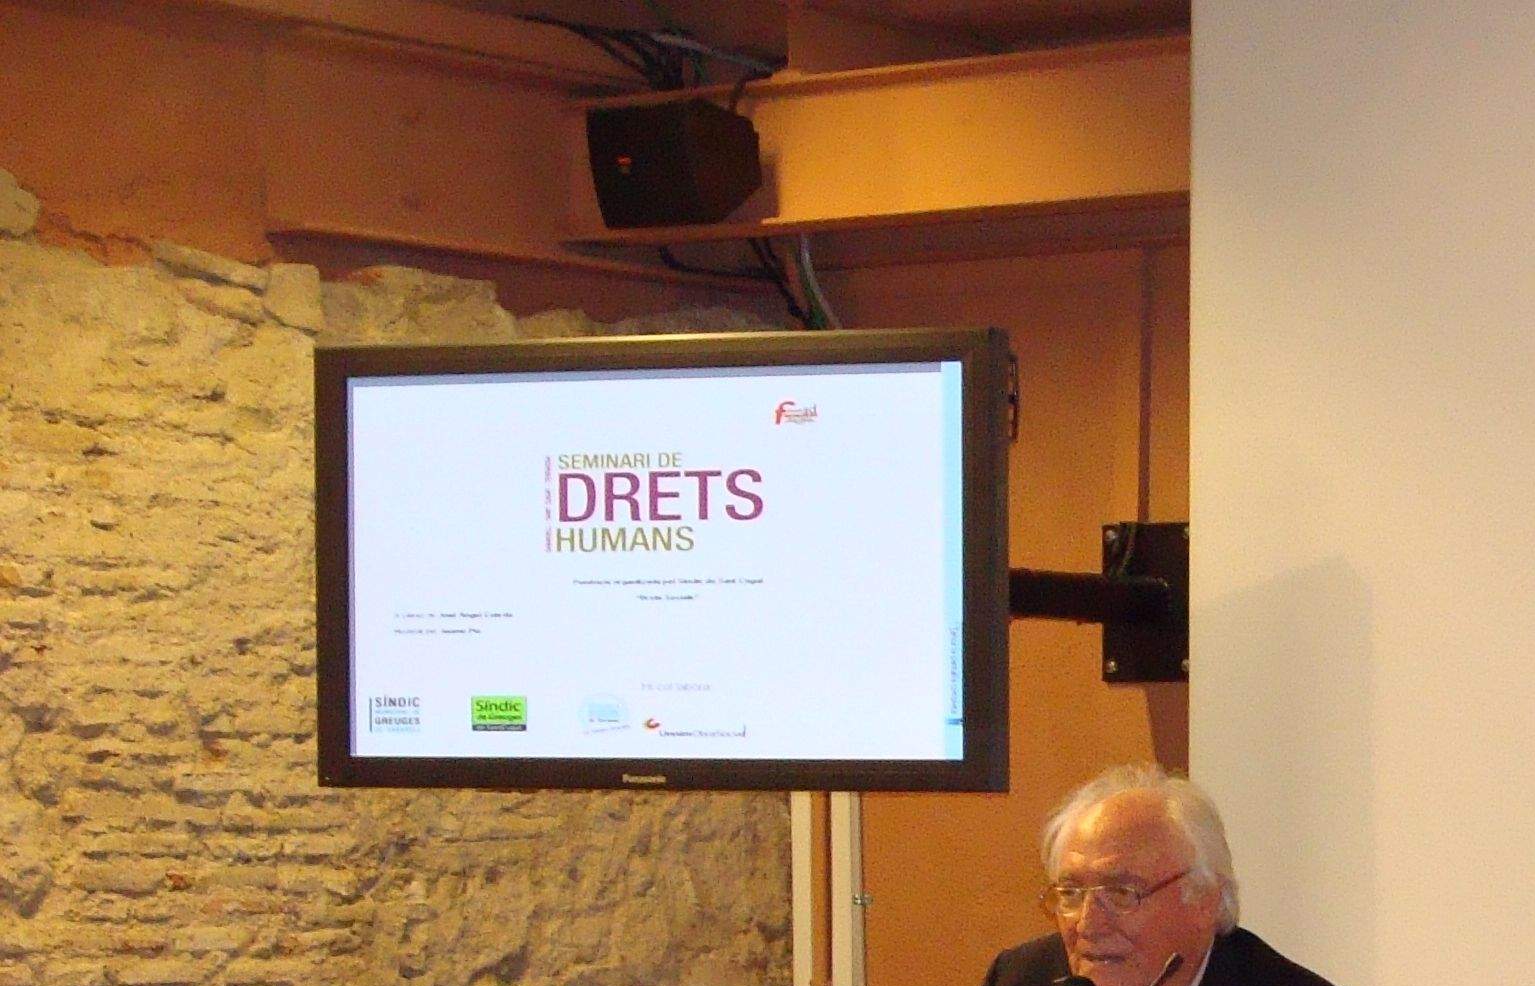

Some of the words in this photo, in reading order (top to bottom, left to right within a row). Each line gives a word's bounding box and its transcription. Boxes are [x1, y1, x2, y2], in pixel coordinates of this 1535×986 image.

[558, 453, 650, 470] SEMINARI
[658, 451, 684, 468] DE
[558, 468, 764, 523] DRETS
[556, 526, 695, 553] HUMANS
